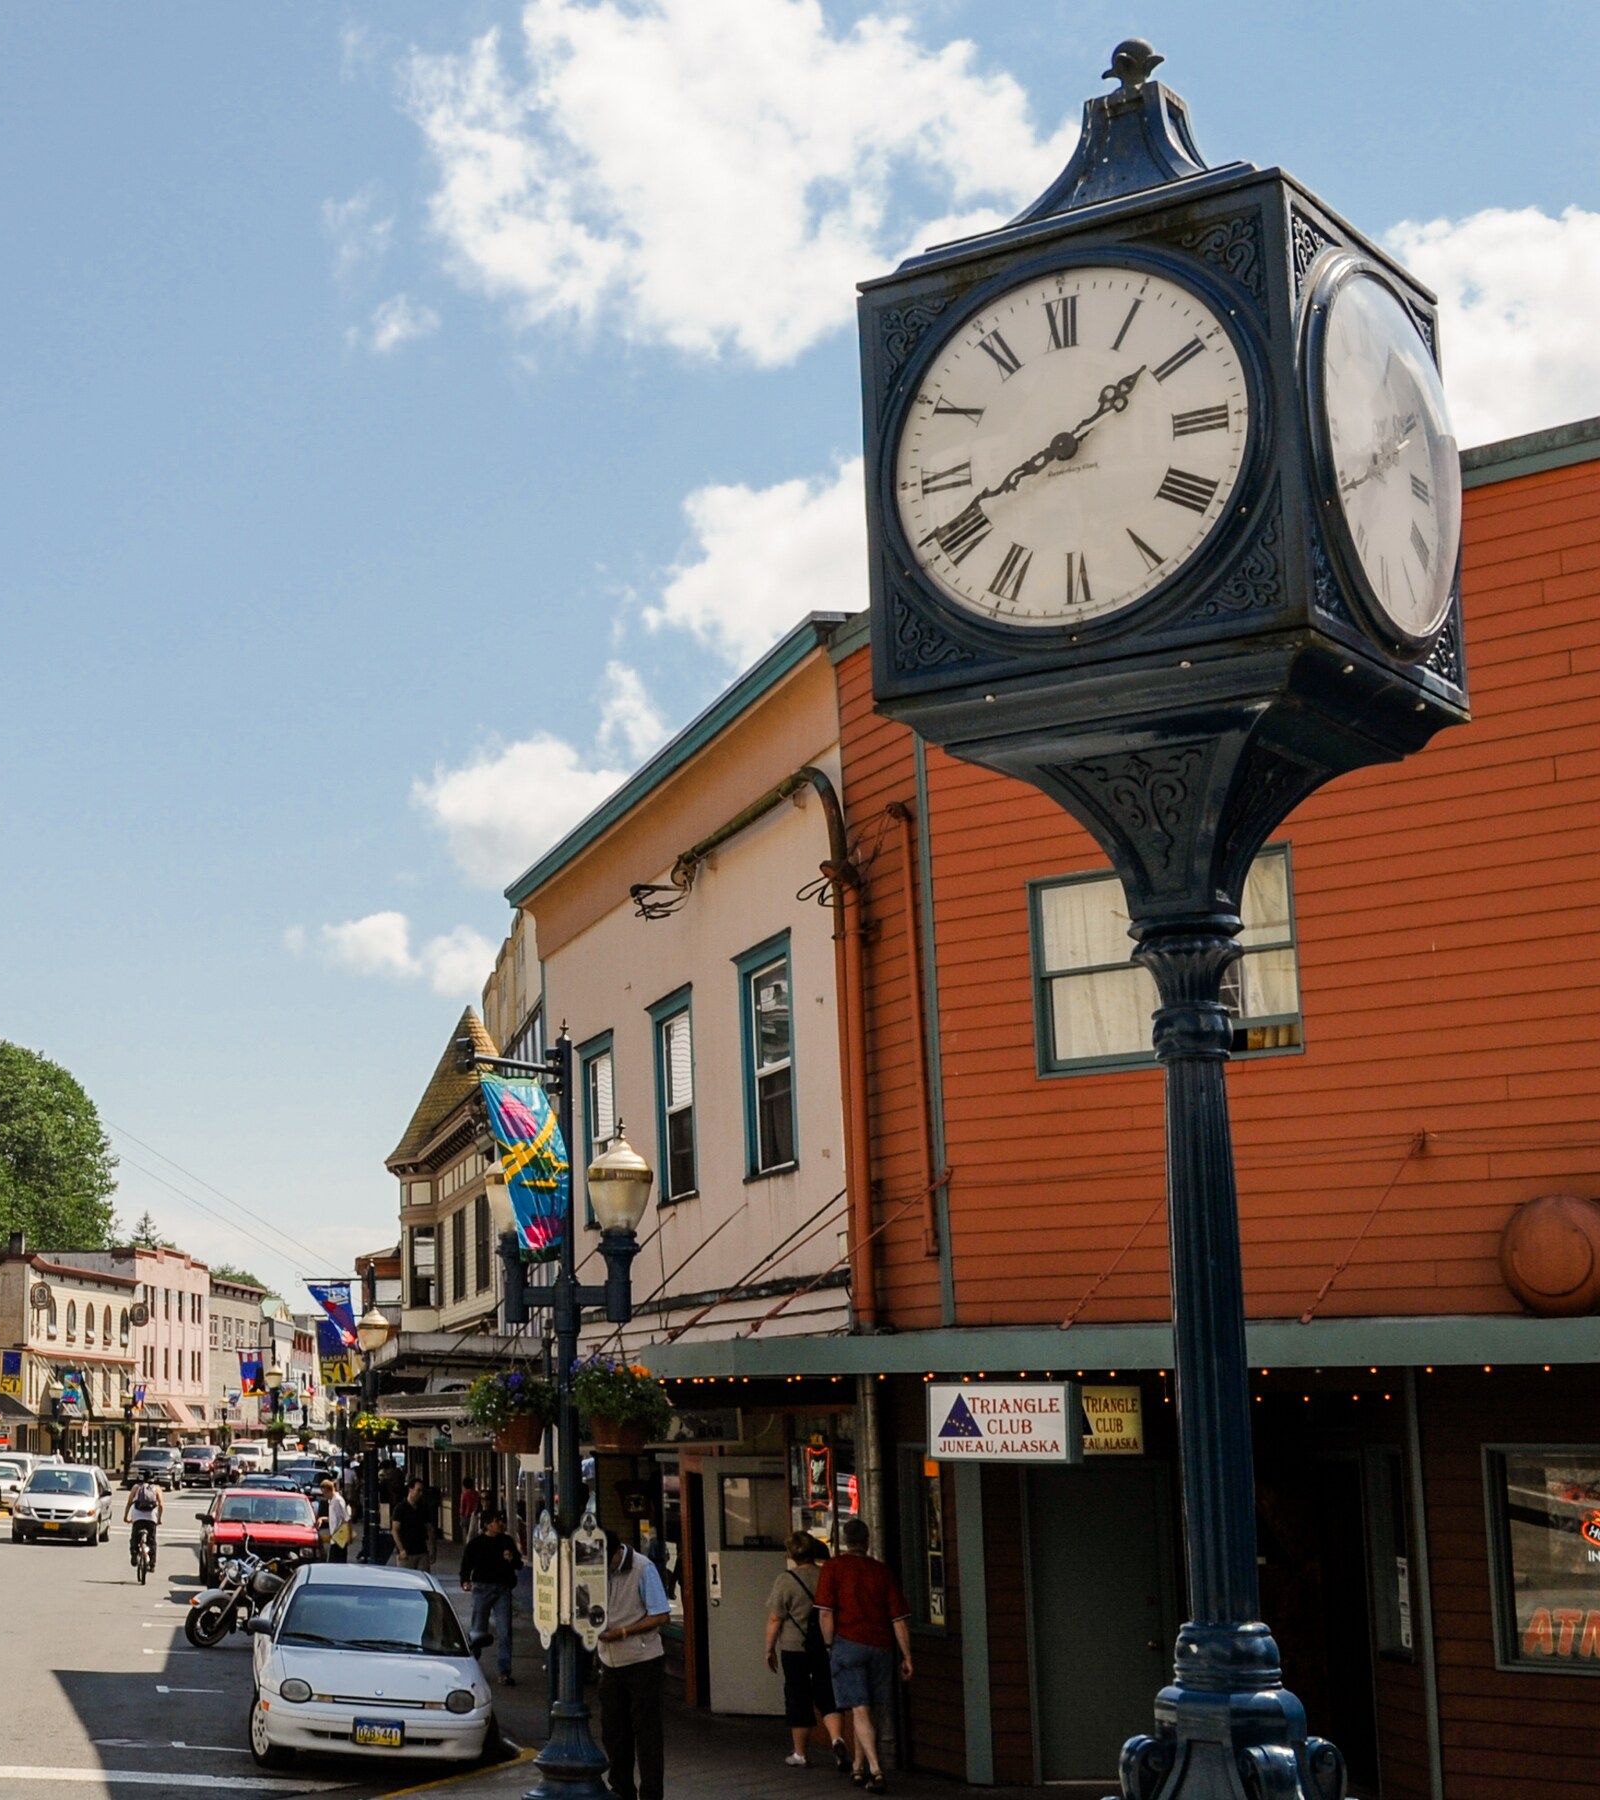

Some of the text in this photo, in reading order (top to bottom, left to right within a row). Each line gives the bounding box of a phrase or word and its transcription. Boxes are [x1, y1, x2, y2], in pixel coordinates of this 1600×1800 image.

[933, 394, 986, 427] X
[1171, 400, 1230, 441] III
[322, 1362, 352, 1385] 50
[0, 1378, 20, 1393] 50
[967, 1396, 1060, 1414] TRIANGLE
[1083, 1395, 1139, 1413] TRIANGLE
[986, 1419, 1033, 1434] CLUB
[1095, 1418, 1123, 1432] CLUB
[1083, 1437, 1103, 1451] EAU,
[382, 1728, 398, 1741] 441
